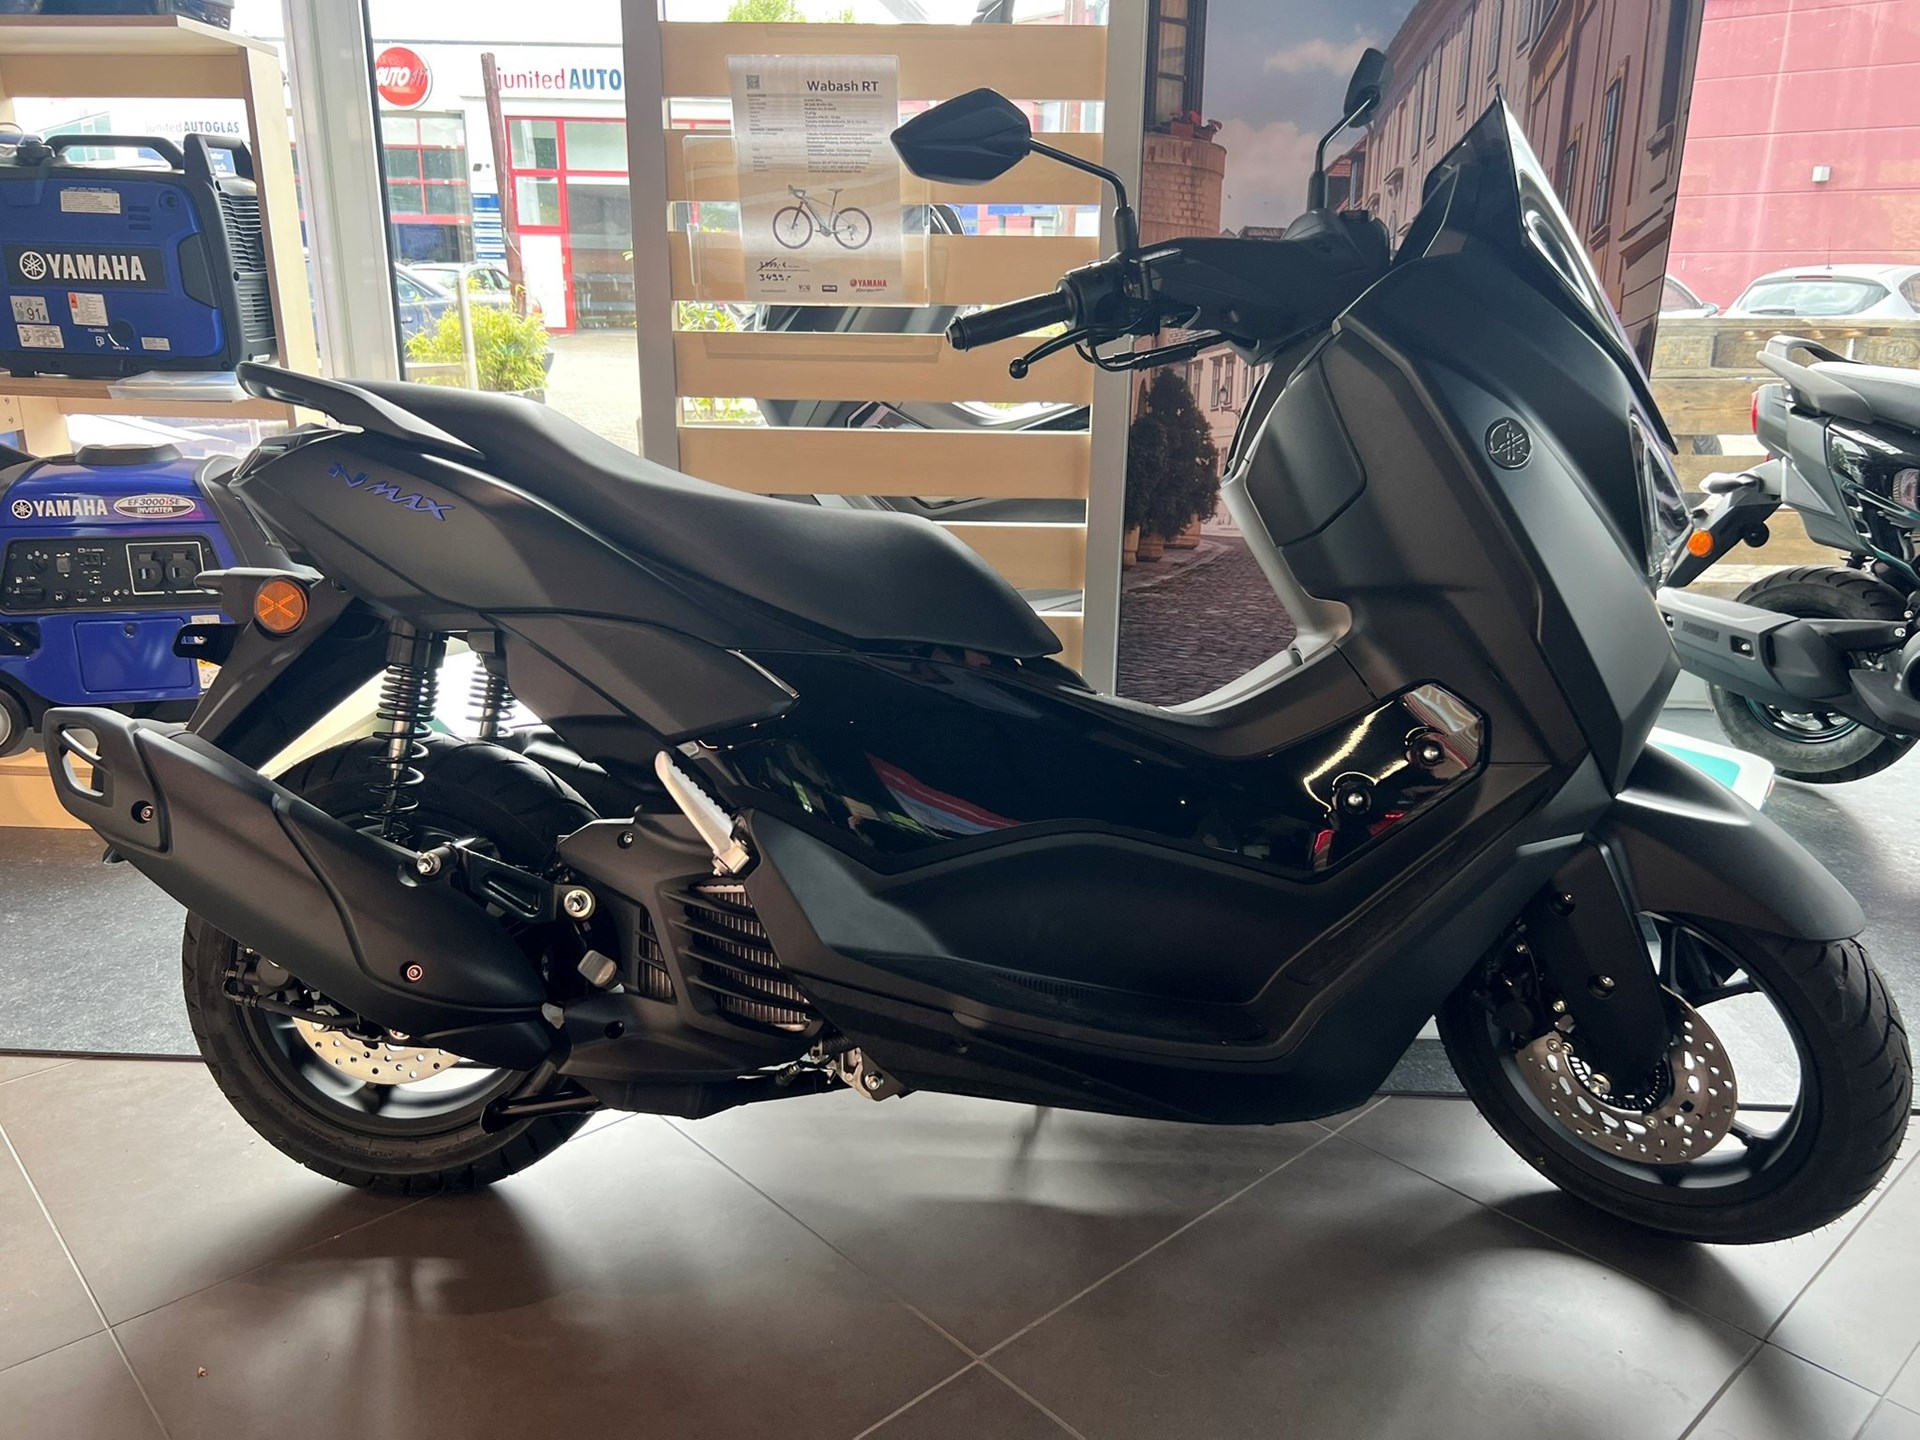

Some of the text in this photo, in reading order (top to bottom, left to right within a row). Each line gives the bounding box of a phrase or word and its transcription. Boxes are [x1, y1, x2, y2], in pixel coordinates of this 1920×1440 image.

[569, 68, 622, 90] AUTO
[806, 80, 879, 92] Wabash RT
[184, 121, 239, 133] AUTOGLAS
[46, 253, 147, 281] YAMAHA
[857, 279, 887, 288] YAMAHA
[32, 499, 109, 518] YAMAHA
[137, 506, 174, 514] INVERTER
